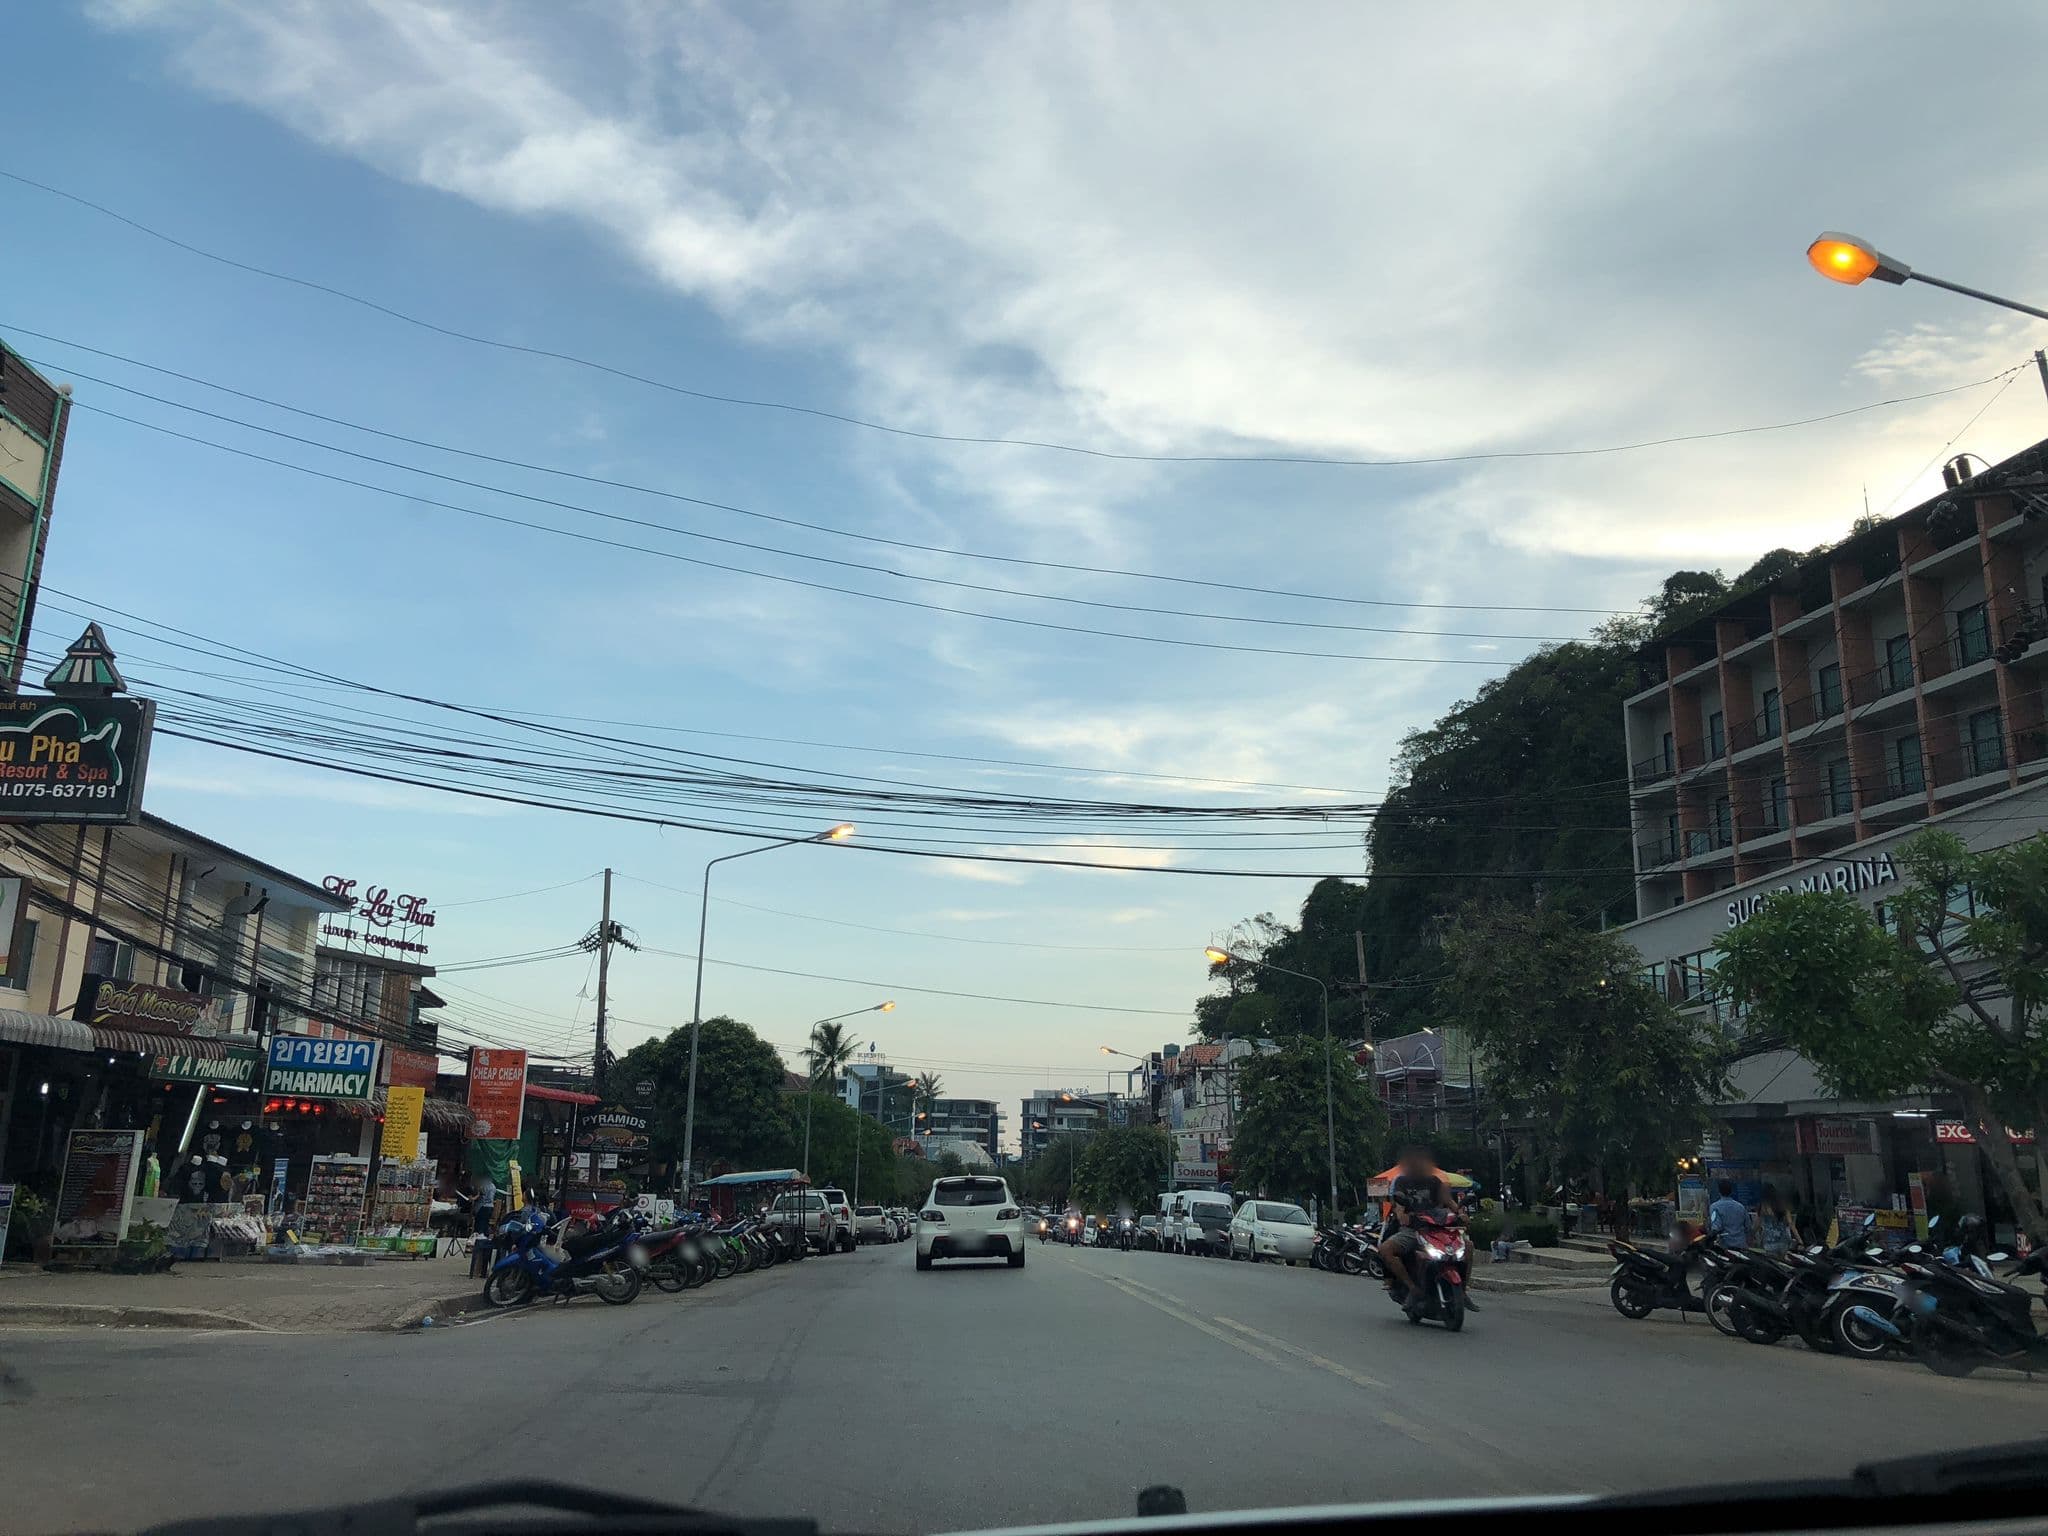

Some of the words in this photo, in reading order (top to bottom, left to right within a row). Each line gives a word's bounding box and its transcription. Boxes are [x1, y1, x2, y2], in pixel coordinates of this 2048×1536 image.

[29, 735, 80, 763] Pha
[56, 763, 69, 780] &
[78, 764, 108, 782] Spa
[1727, 885, 1792, 928] SUG
[1800, 852, 1896, 896] MARINA
[397, 894, 436, 927] Thai
[323, 924, 358, 940] LUXURY
[96, 981, 138, 1015] Dara
[136, 990, 198, 1031] Massage
[275, 1039, 370, 1066] ขายยา
[168, 1055, 180, 1074] K
[180, 1056, 192, 1076] A
[194, 1057, 256, 1081] PHARMACY
[473, 1067, 497, 1080] CHEAP
[498, 1068, 523, 1081] CHEAP
[268, 1070, 367, 1095] PHARMACY
[582, 1114, 647, 1129] PYRAMIDS
